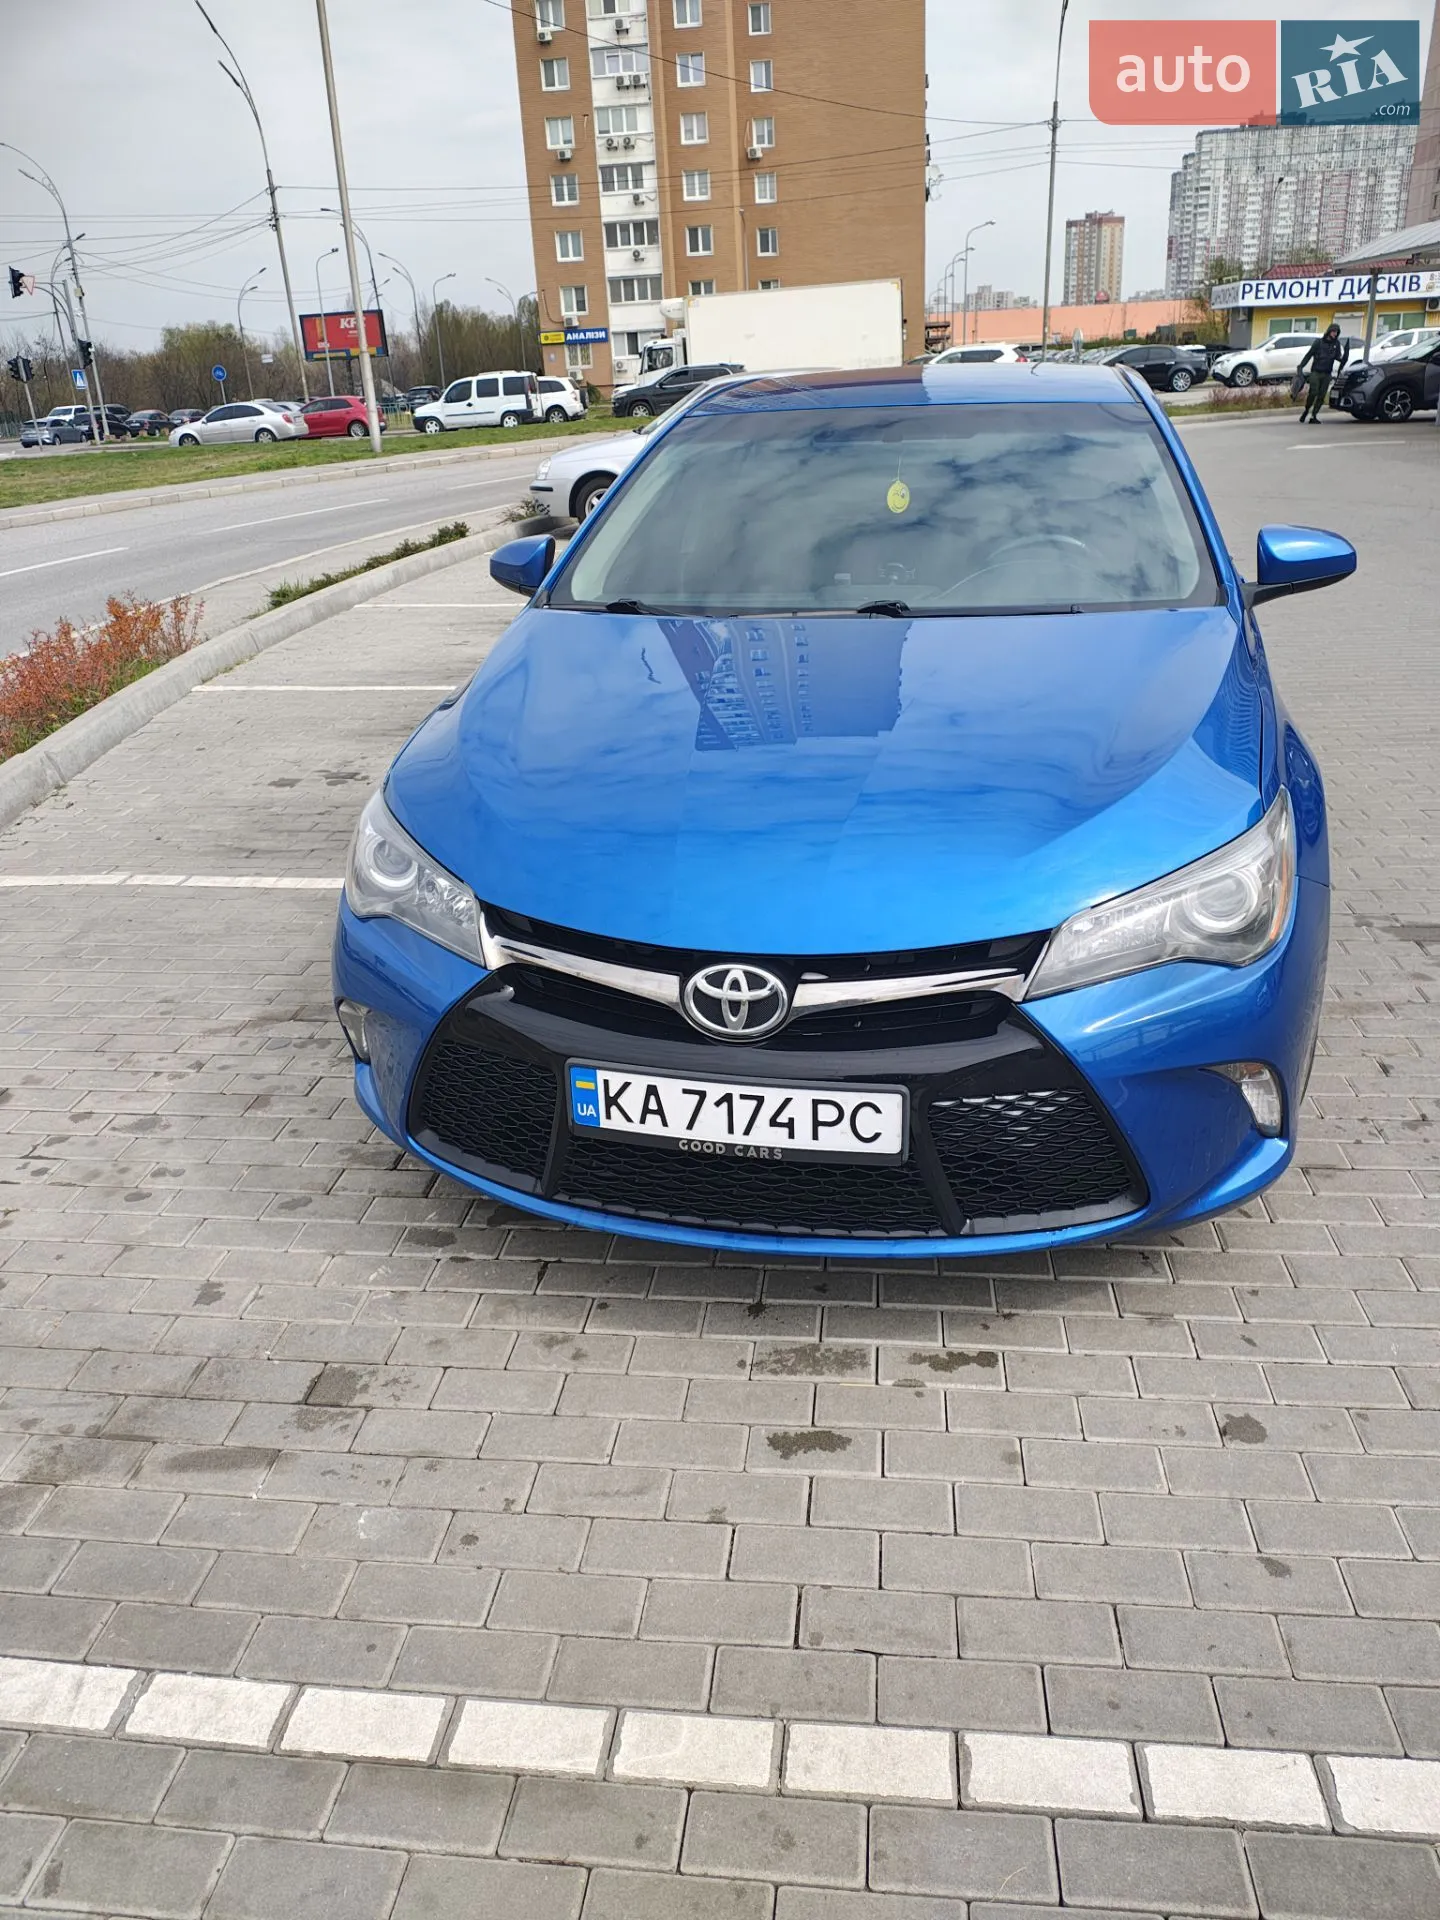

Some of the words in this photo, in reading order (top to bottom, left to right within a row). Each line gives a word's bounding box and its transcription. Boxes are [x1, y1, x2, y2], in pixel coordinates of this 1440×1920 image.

[1241, 278, 1334, 301] РЕМОНТ
[1338, 274, 1421, 301] ДИСКІВ
[566, 330, 606, 341] АНАЛІЗИ
[577, 1103, 597, 1118] UA
[681, 1088, 795, 1140] 7174
[678, 1139, 726, 1155] GOOD
[734, 1144, 783, 1161] CARS
